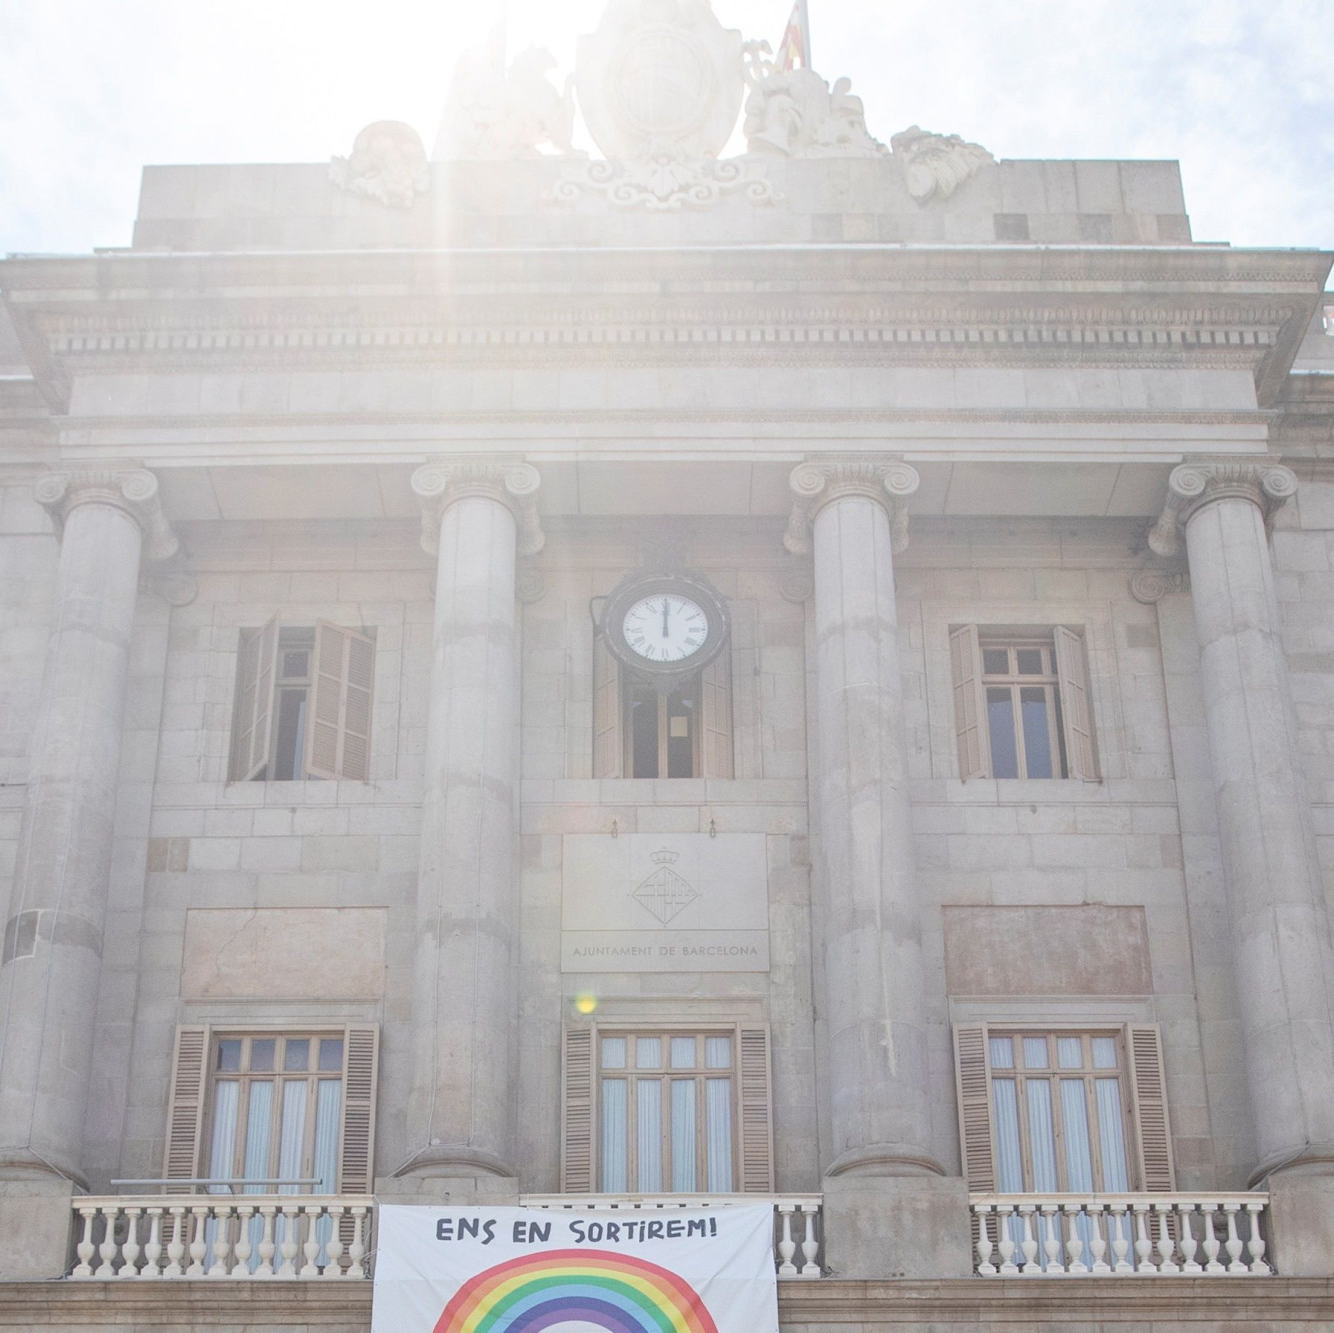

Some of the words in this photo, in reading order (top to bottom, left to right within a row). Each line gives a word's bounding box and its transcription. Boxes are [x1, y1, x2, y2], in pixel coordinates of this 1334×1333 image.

[572, 946, 652, 957] AJUNTAMENT
[659, 946, 676, 956] DE
[683, 945, 759, 956] BARCELONA
[436, 1217, 497, 1245] ENS
[513, 1220, 552, 1244] EN
